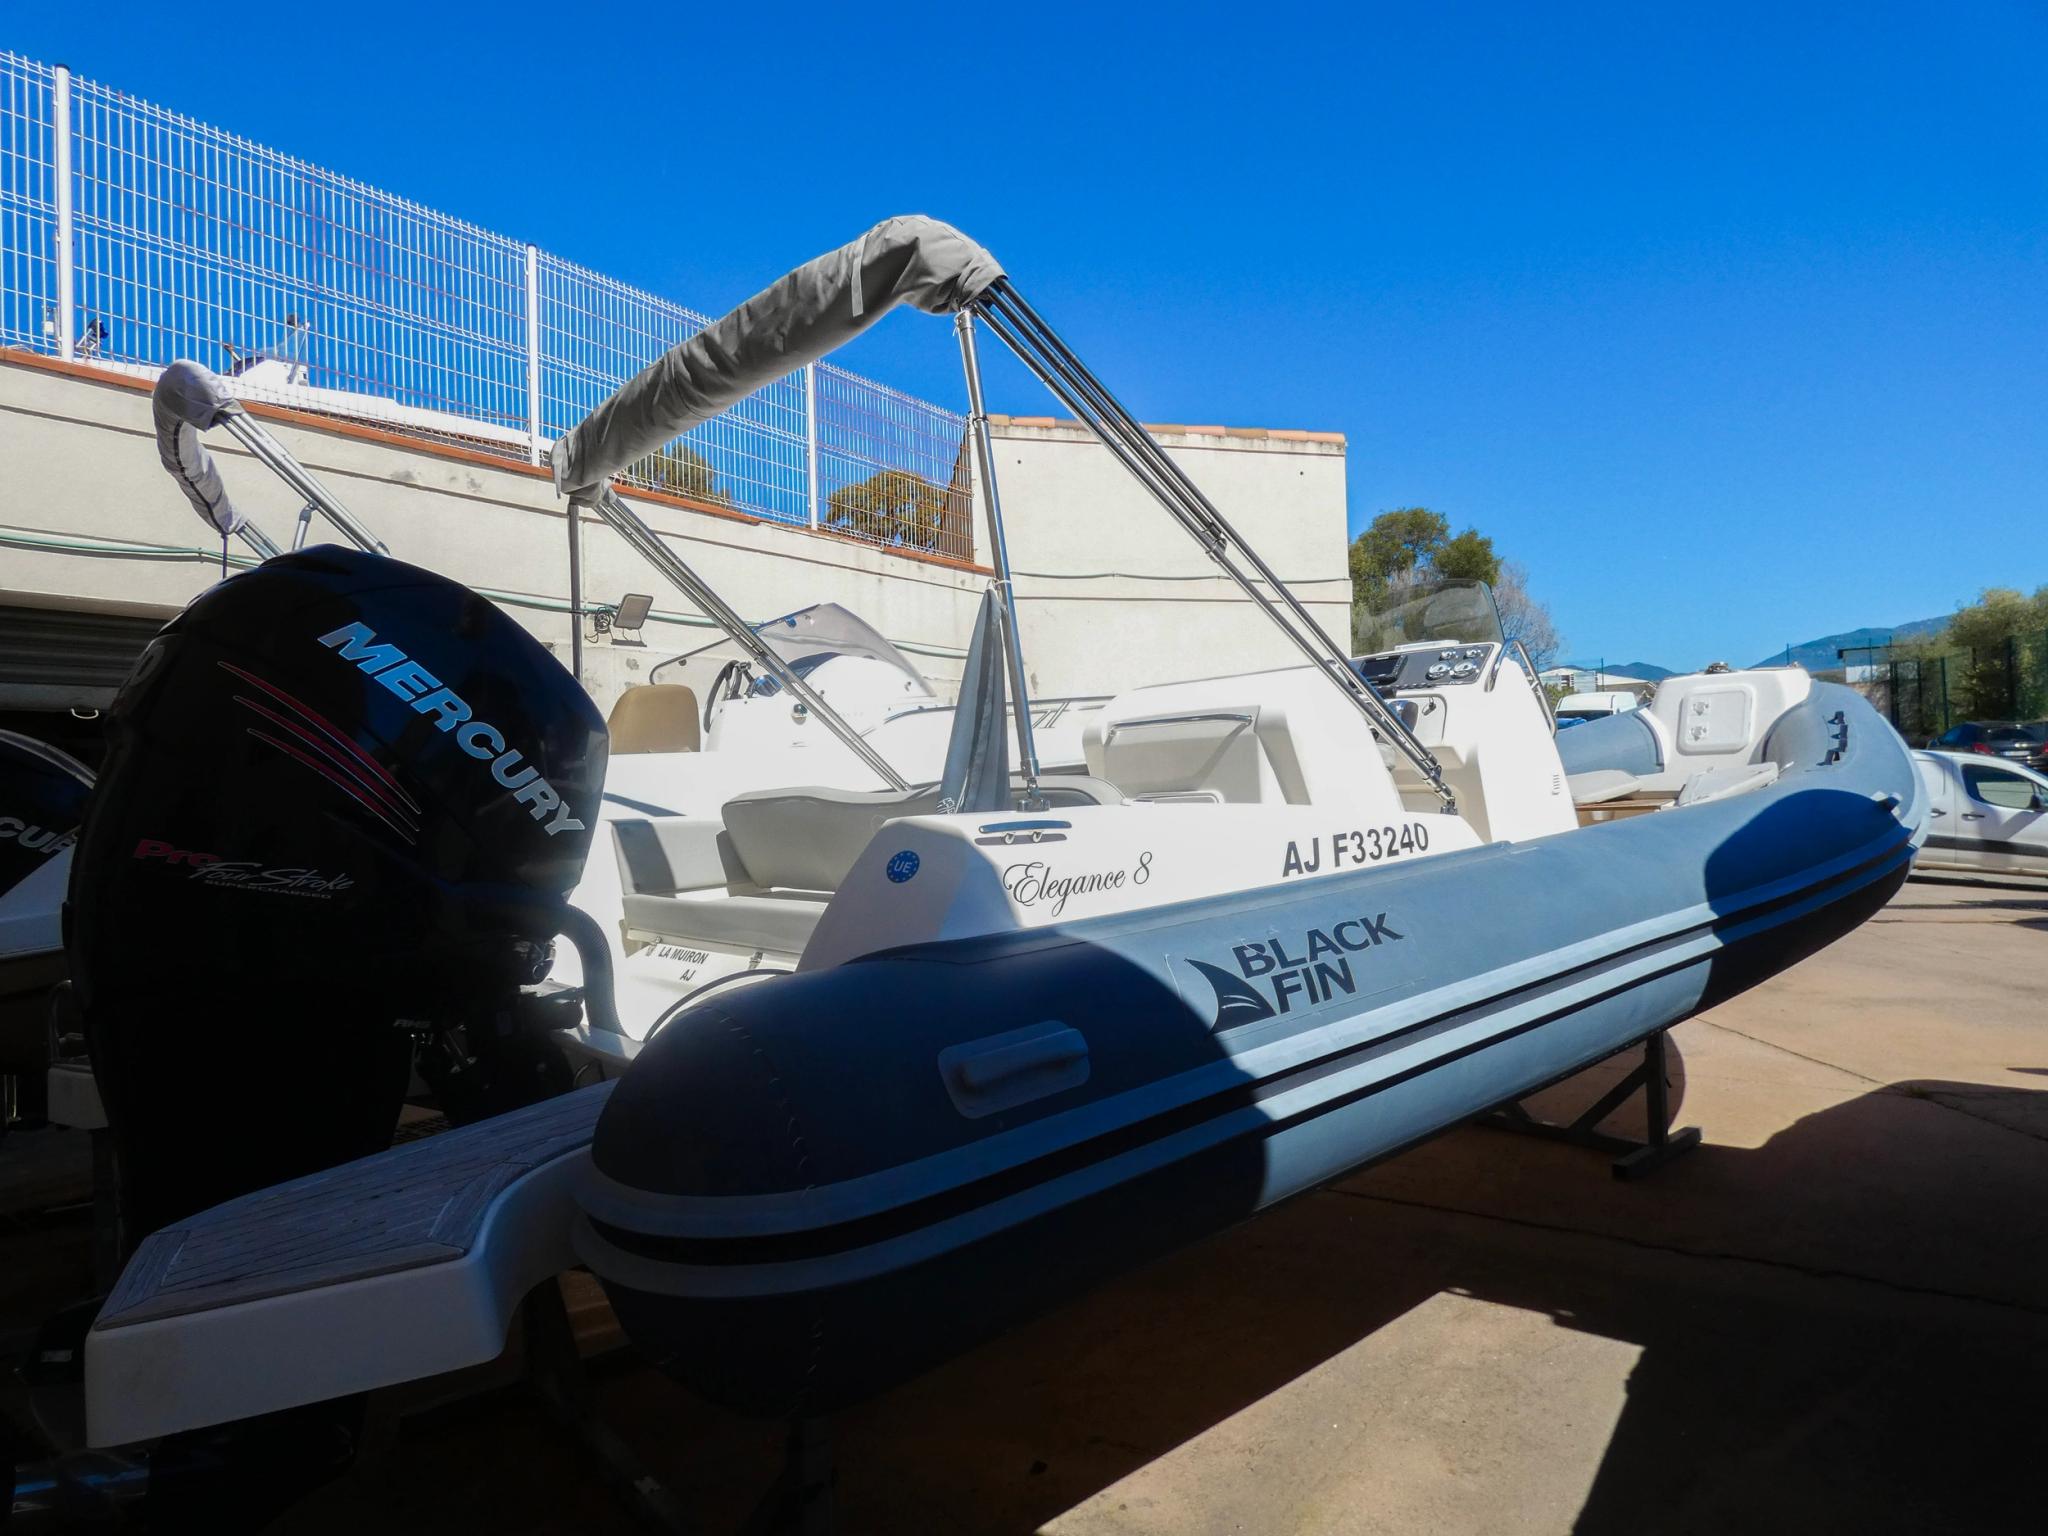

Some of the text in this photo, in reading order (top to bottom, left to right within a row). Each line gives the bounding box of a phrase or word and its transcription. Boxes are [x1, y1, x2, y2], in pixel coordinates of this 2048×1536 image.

[317, 621, 585, 836] MERCURY
[133, 838, 222, 868] Pro
[894, 860, 912, 873] UE
[1282, 822, 1429, 877] AJ F33240
[1003, 851, 1153, 917] Elegance 8
[658, 946, 710, 964] LA MUIRON
[1231, 912, 1405, 979] BLACK
[680, 969, 697, 981] AJ
[1271, 957, 1356, 1014] FIN
